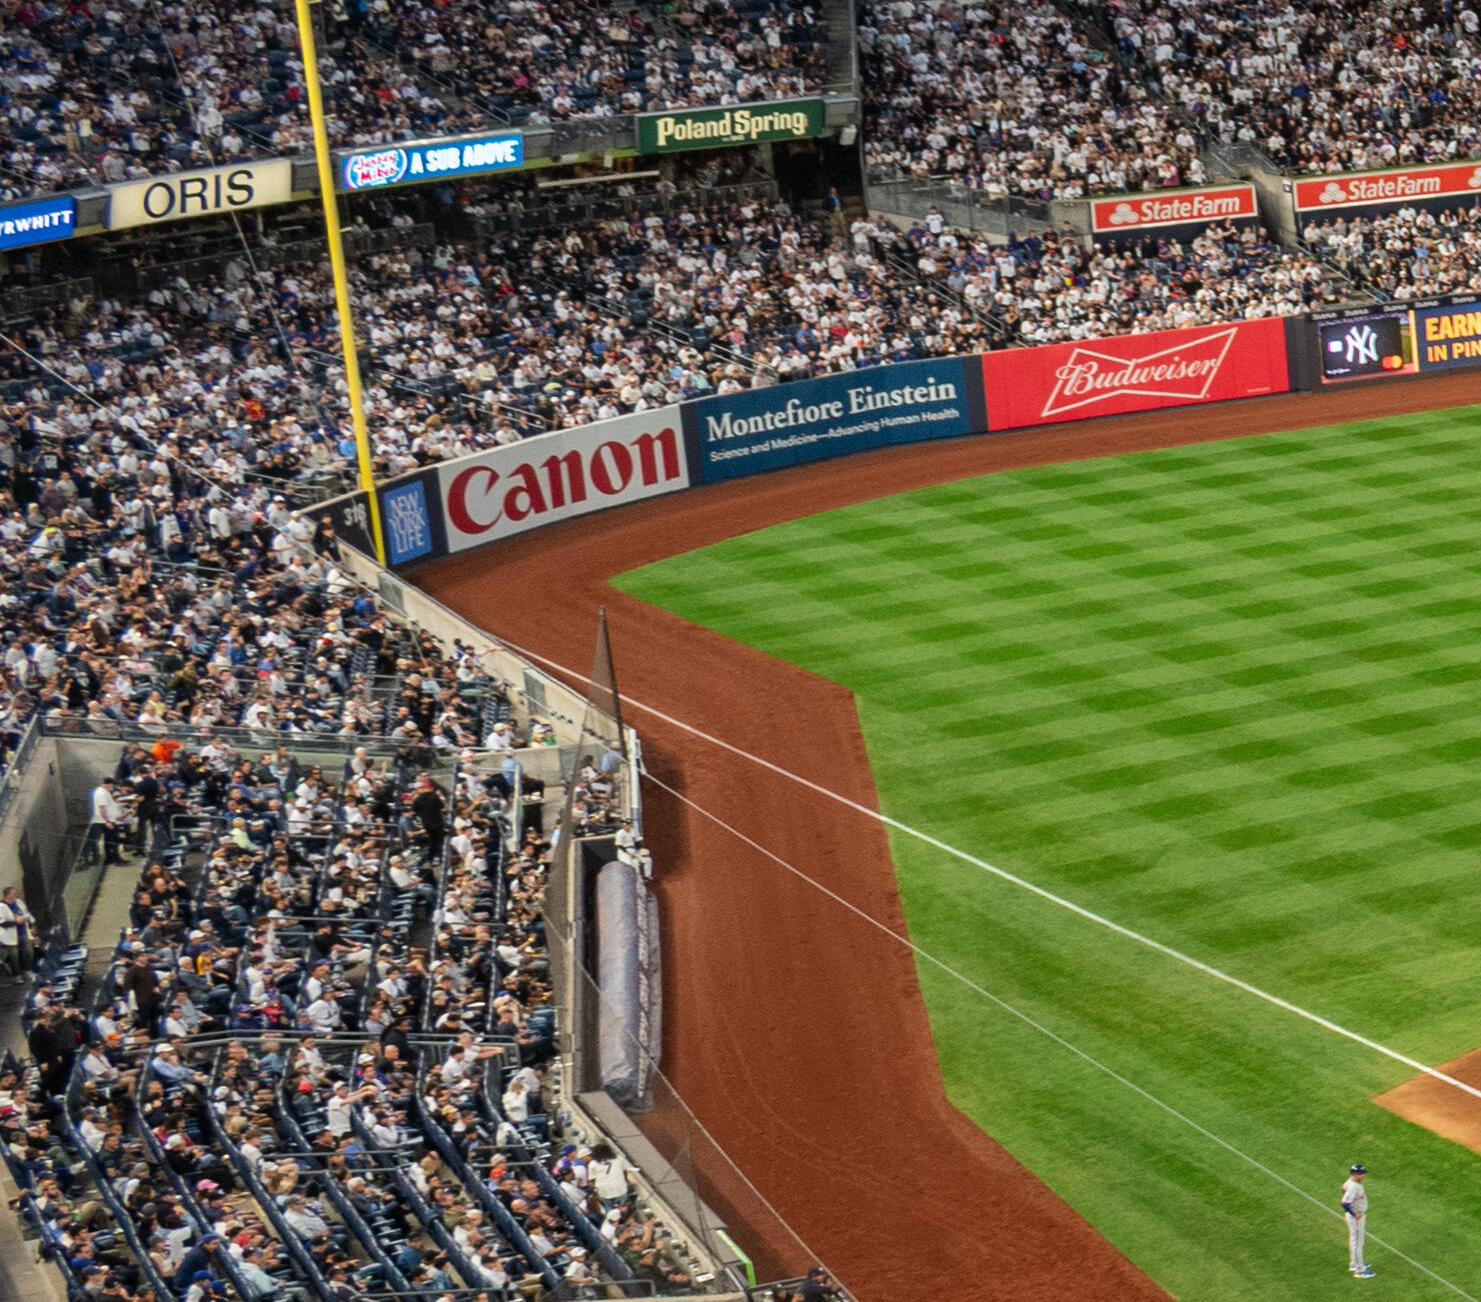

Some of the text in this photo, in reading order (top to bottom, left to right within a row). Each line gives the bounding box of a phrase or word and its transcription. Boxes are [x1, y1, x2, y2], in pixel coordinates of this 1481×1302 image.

[656, 109, 807, 147] Poland Spring
[142, 169, 255, 219] ORIS
[1140, 196, 1240, 221] StateFarm
[1055, 353, 1220, 397] Budweiser
[1427, 345, 1447, 362] IN
[706, 377, 957, 442] Montefiore Einstein
[446, 426, 682, 535] Canon
